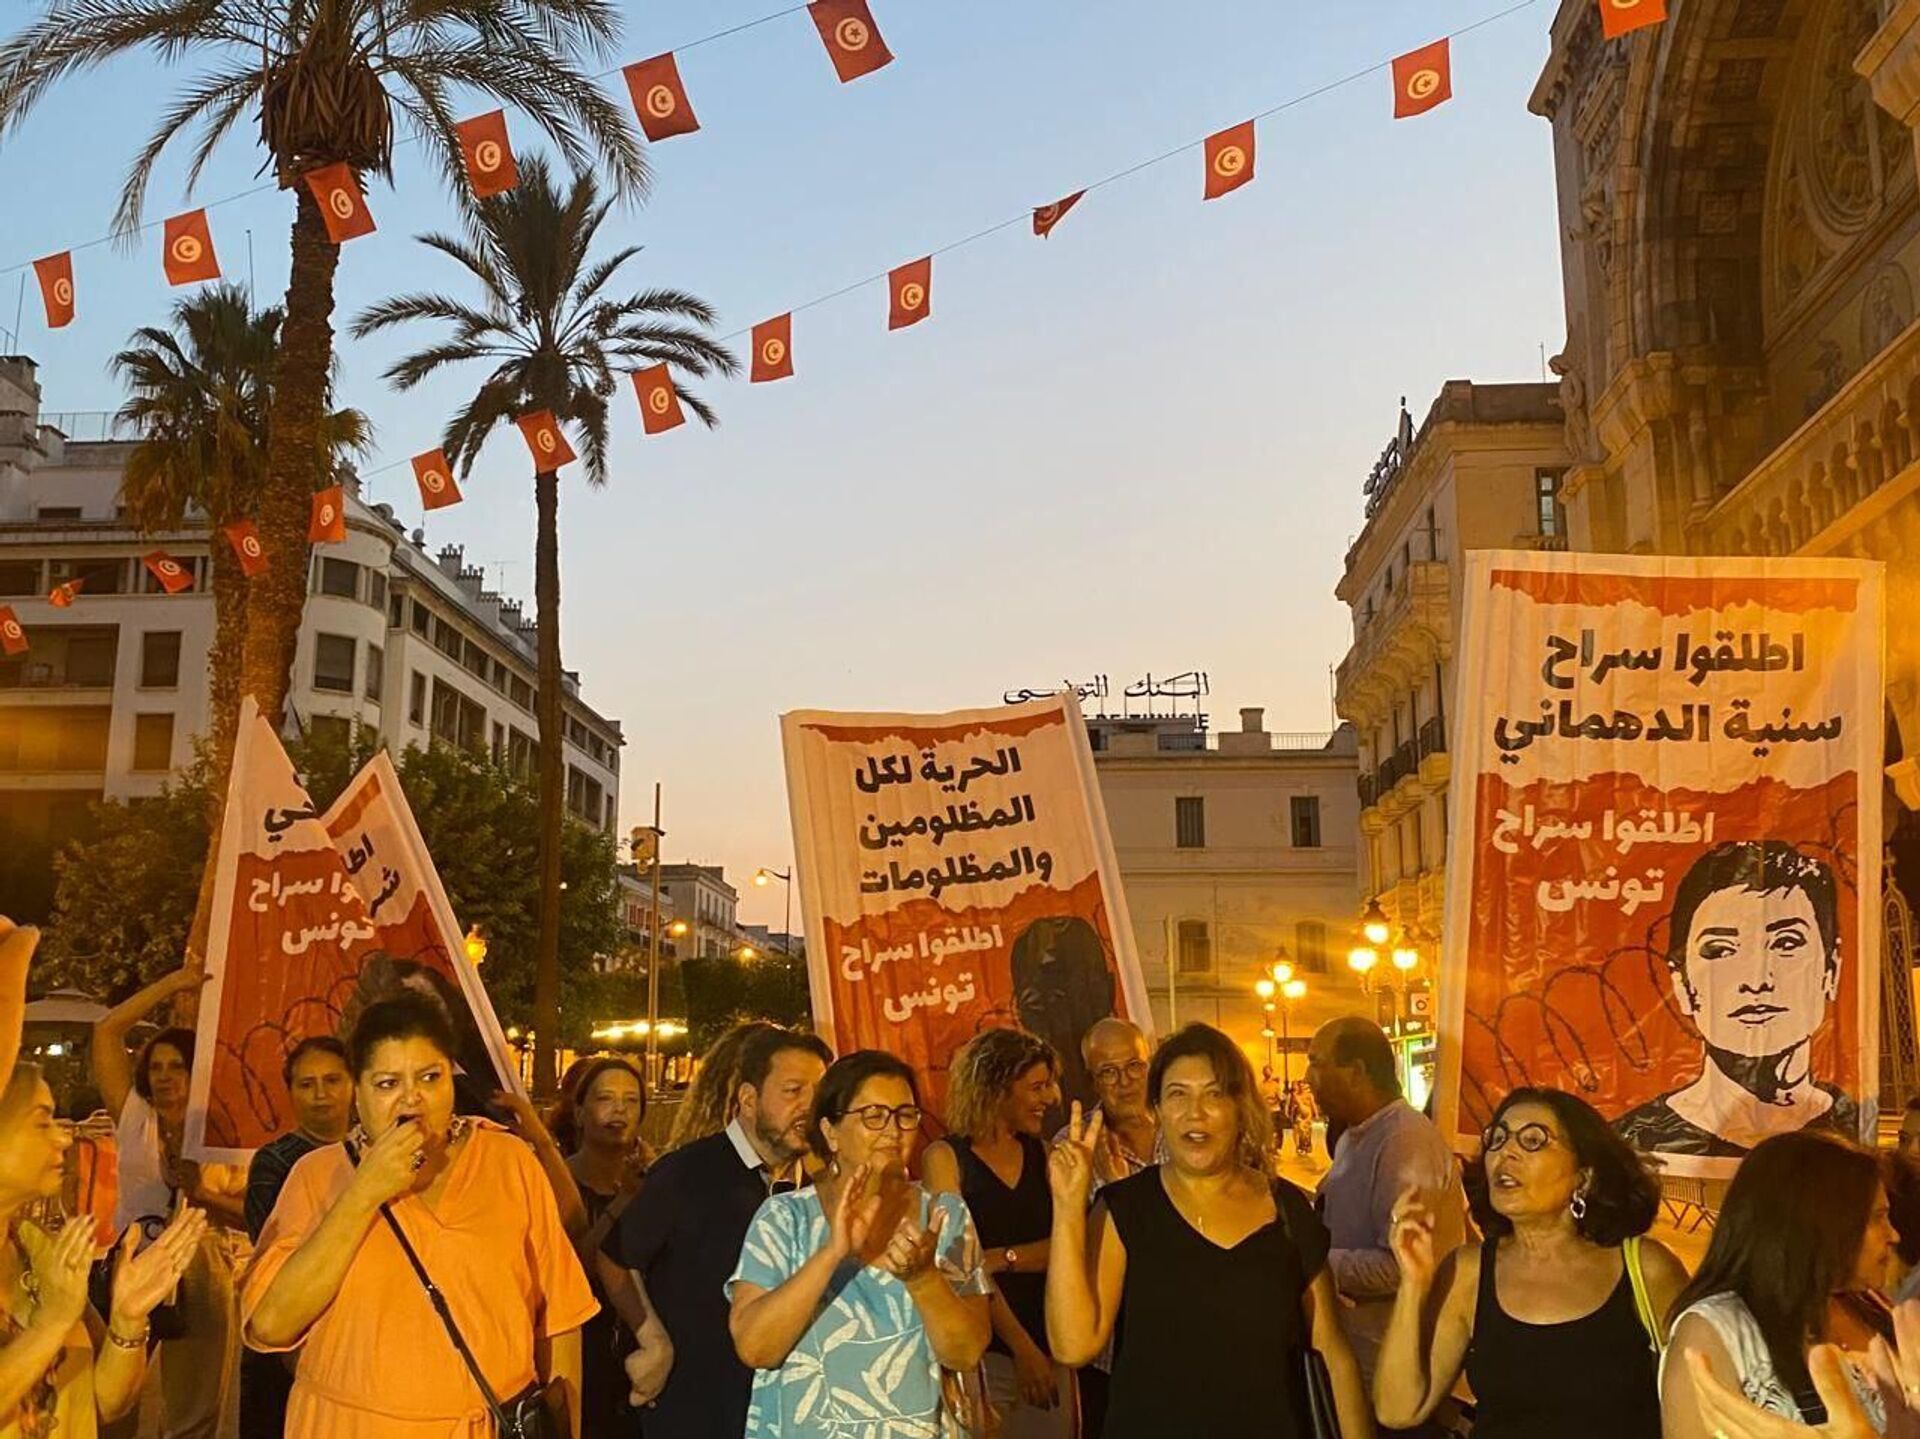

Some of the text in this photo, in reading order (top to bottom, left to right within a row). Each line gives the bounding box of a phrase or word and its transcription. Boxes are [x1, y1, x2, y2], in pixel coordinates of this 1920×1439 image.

[1541, 629, 1805, 689] اطلقوا سراح
[1124, 672, 1209, 699] البنك
[1494, 698, 1842, 765] سنية الدهماني
[856, 747, 1022, 793] الحرية لكل
[859, 794, 1036, 850] المظلومين
[1491, 804, 1715, 855] اطلقوا سراح
[247, 871, 324, 912] سراح
[860, 846, 1052, 899] والمظلومات
[1536, 865, 1665, 915] تونس
[282, 912, 375, 955] تونس
[840, 924, 1004, 981] اطلقوا سراح
[883, 972, 976, 1022] تونس
